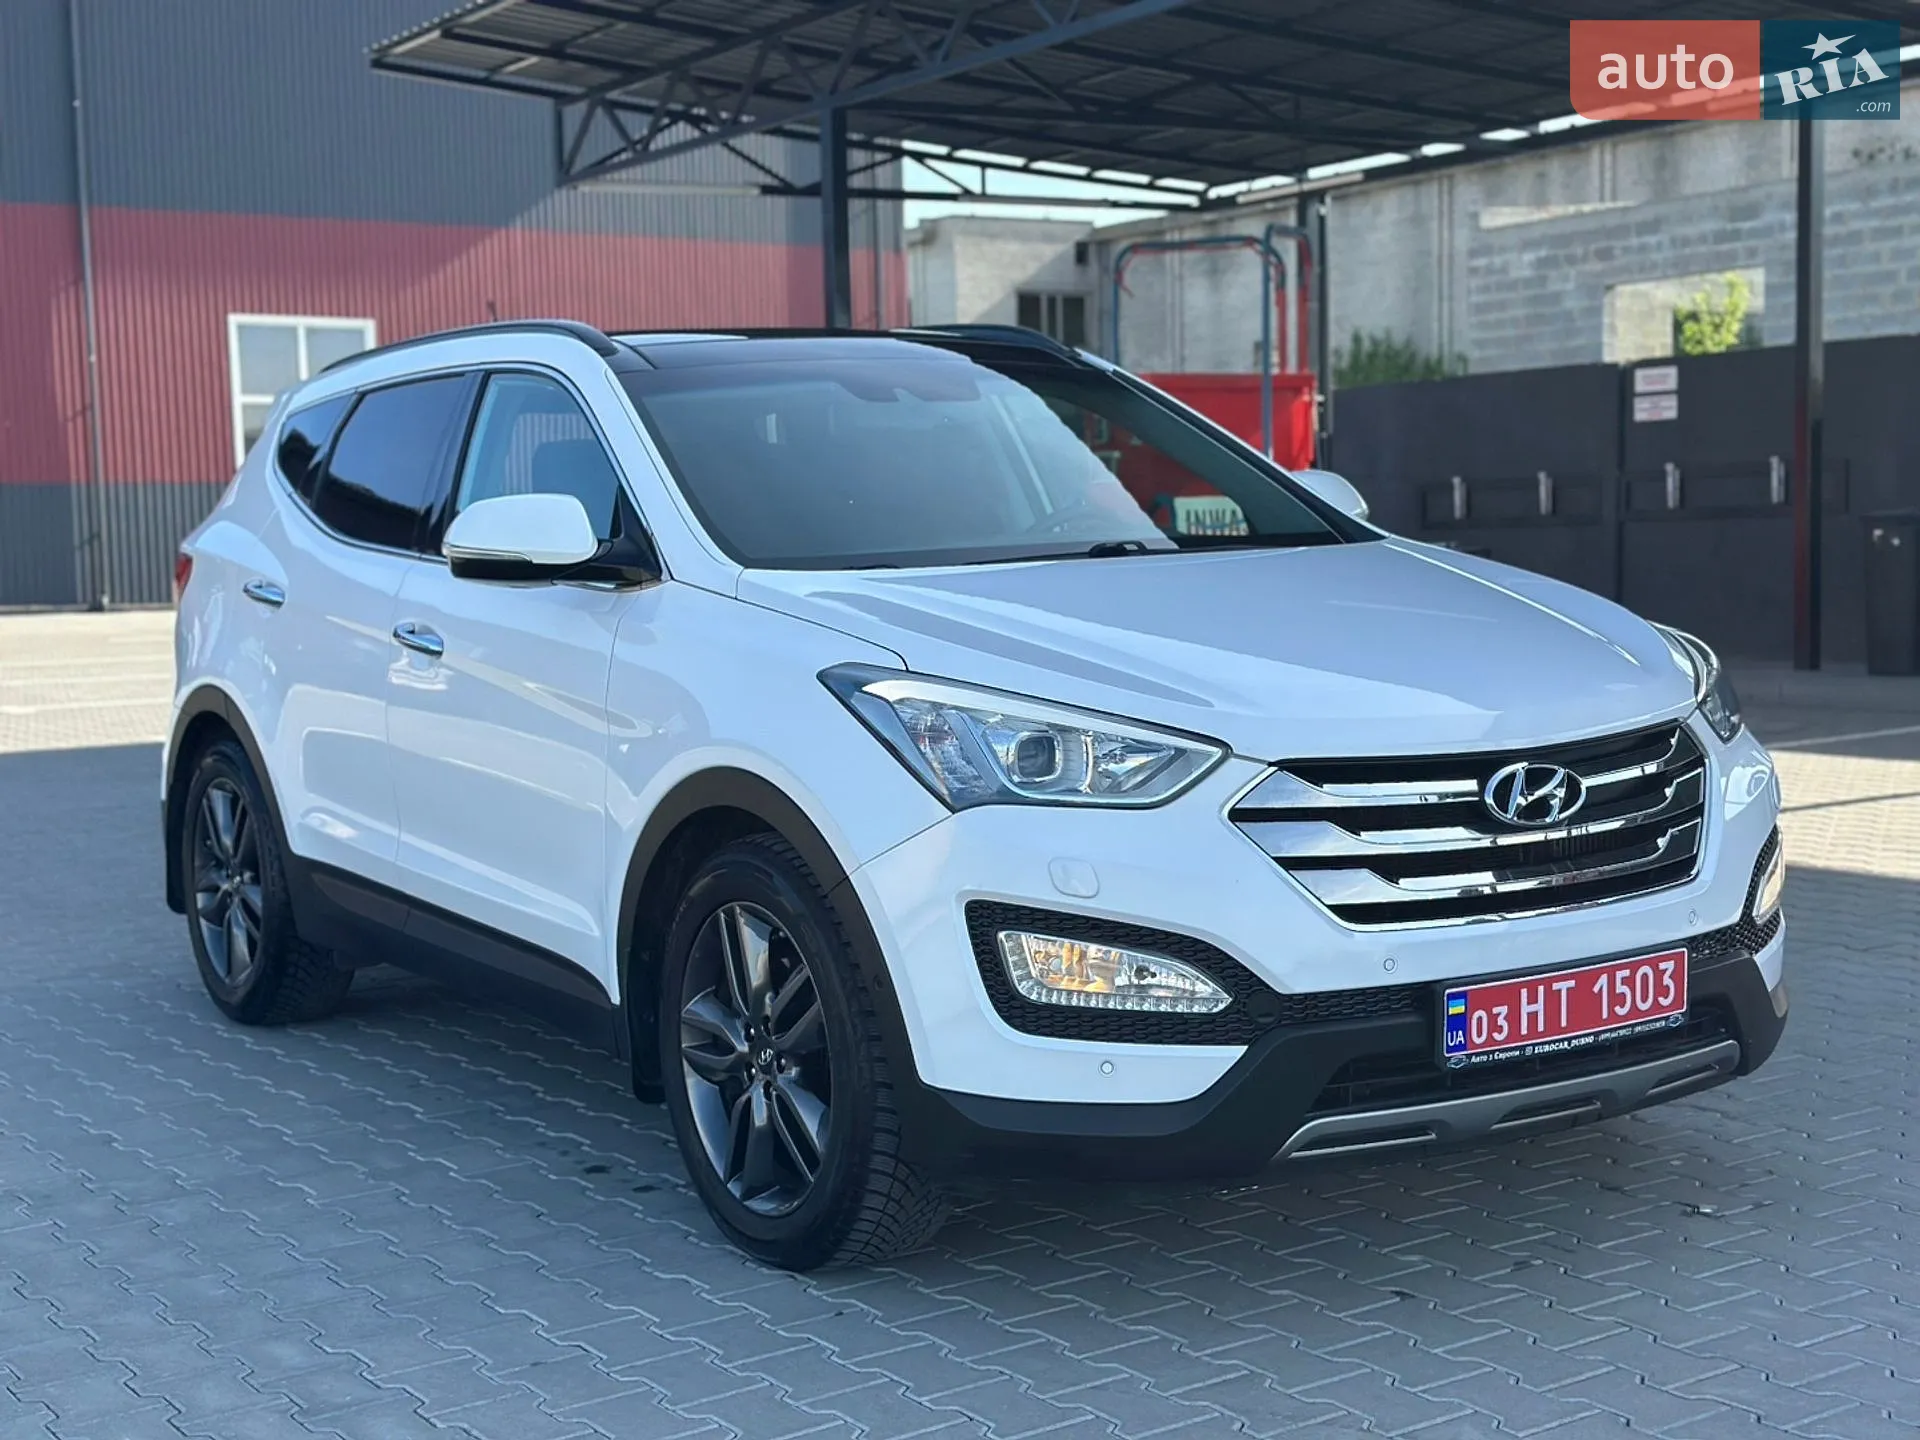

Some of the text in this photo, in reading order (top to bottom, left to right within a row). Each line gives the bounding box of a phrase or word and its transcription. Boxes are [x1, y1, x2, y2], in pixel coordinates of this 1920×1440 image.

[1471, 960, 1676, 1045] 03 HT 1503
[1448, 1030, 1465, 1047] UA
